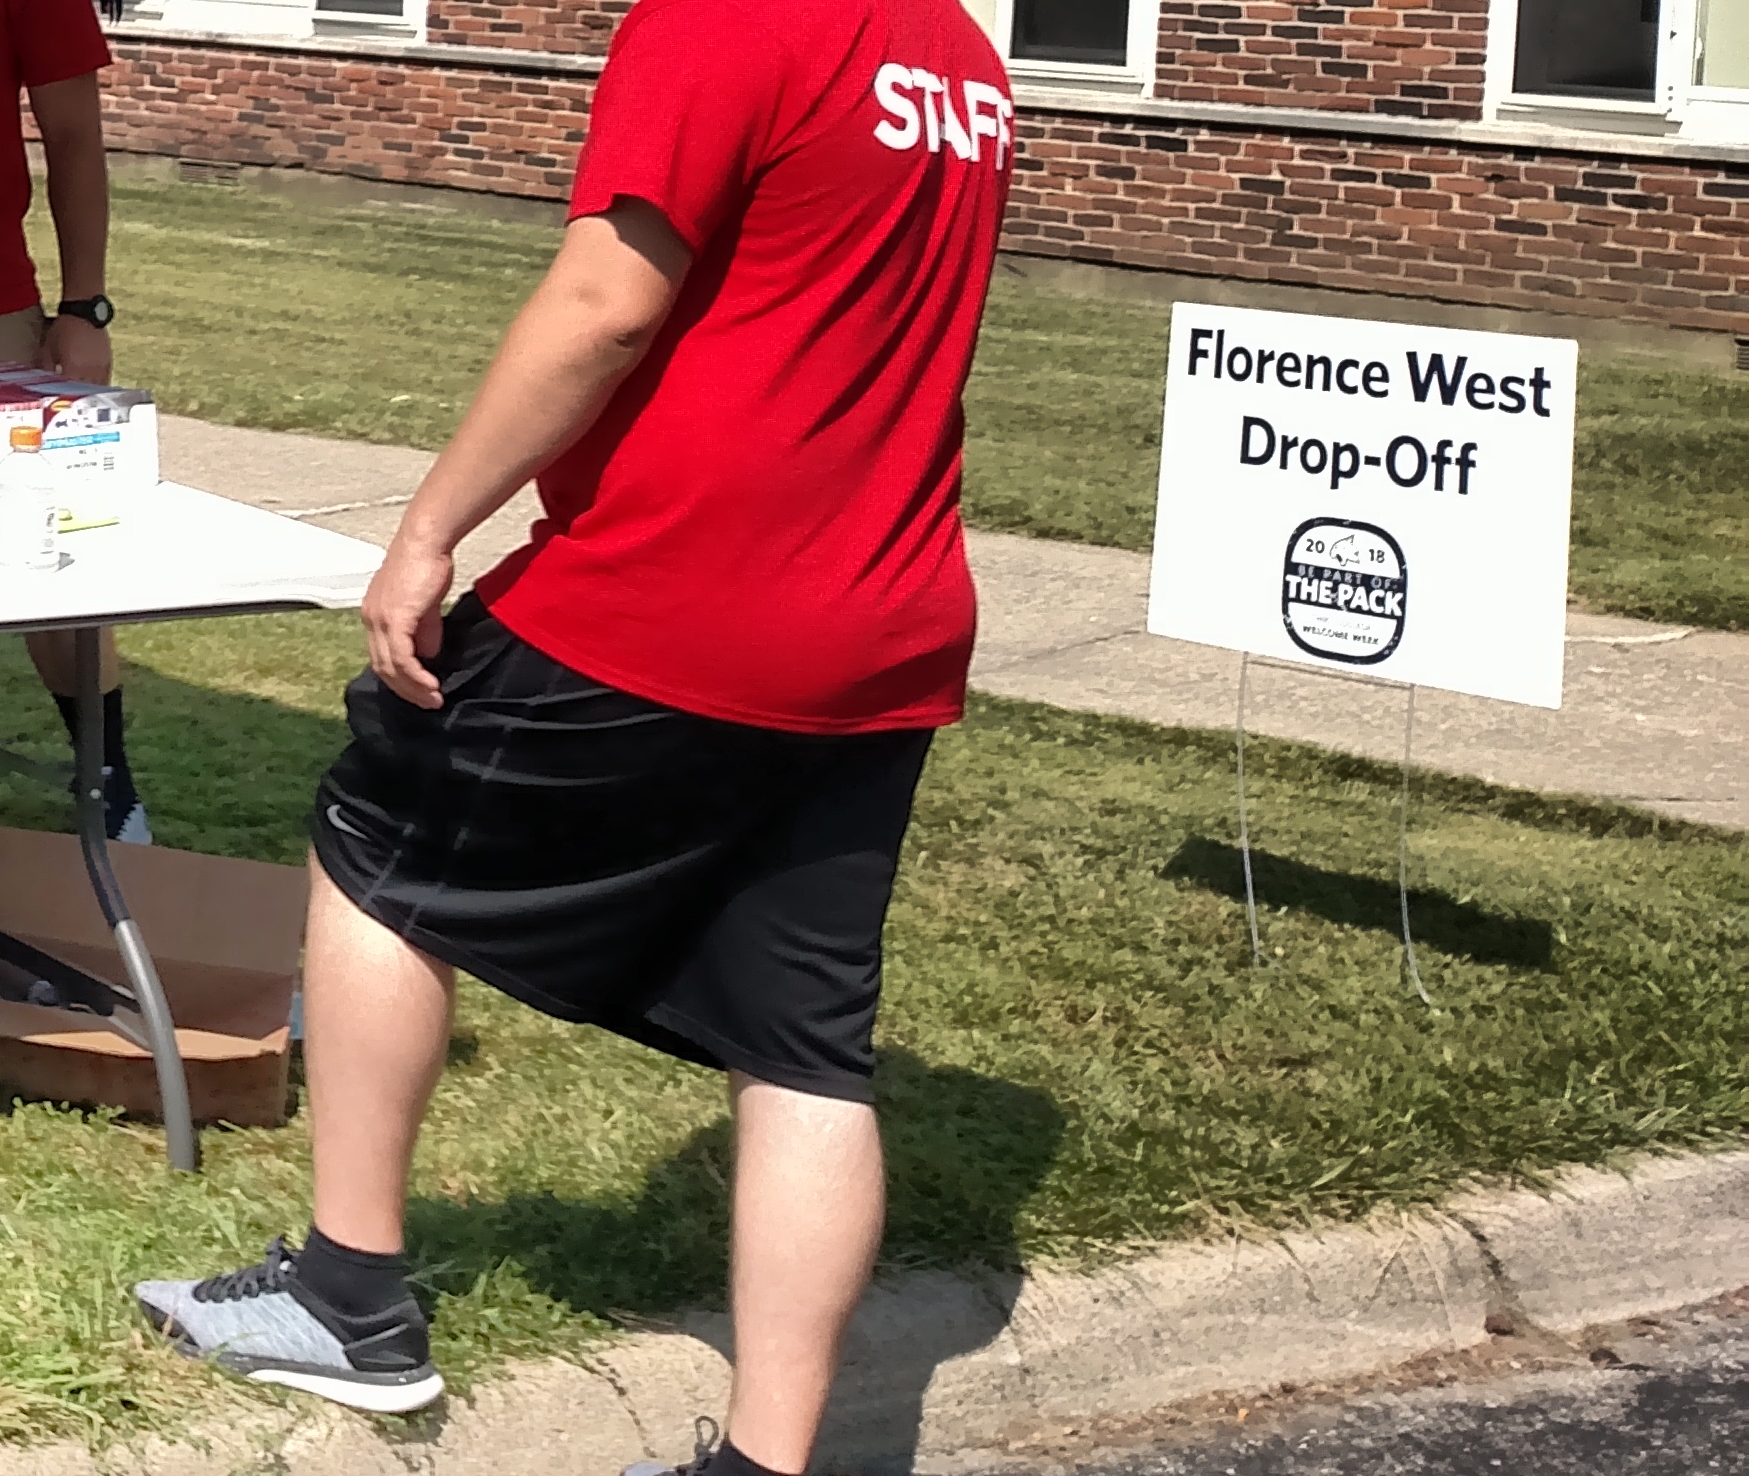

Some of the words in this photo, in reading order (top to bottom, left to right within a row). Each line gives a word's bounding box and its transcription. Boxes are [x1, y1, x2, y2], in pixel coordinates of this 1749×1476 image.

[1187, 328, 1390, 398] Florence
[1406, 350, 1551, 417] West
[1239, 415, 1477, 495] Drop-Off
[1306, 539, 1325, 553] 20
[1369, 549, 1385, 563] 18
[1286, 575, 1333, 604] THE
[1337, 583, 1404, 616] PACK
[1323, 569, 1363, 584] PART
